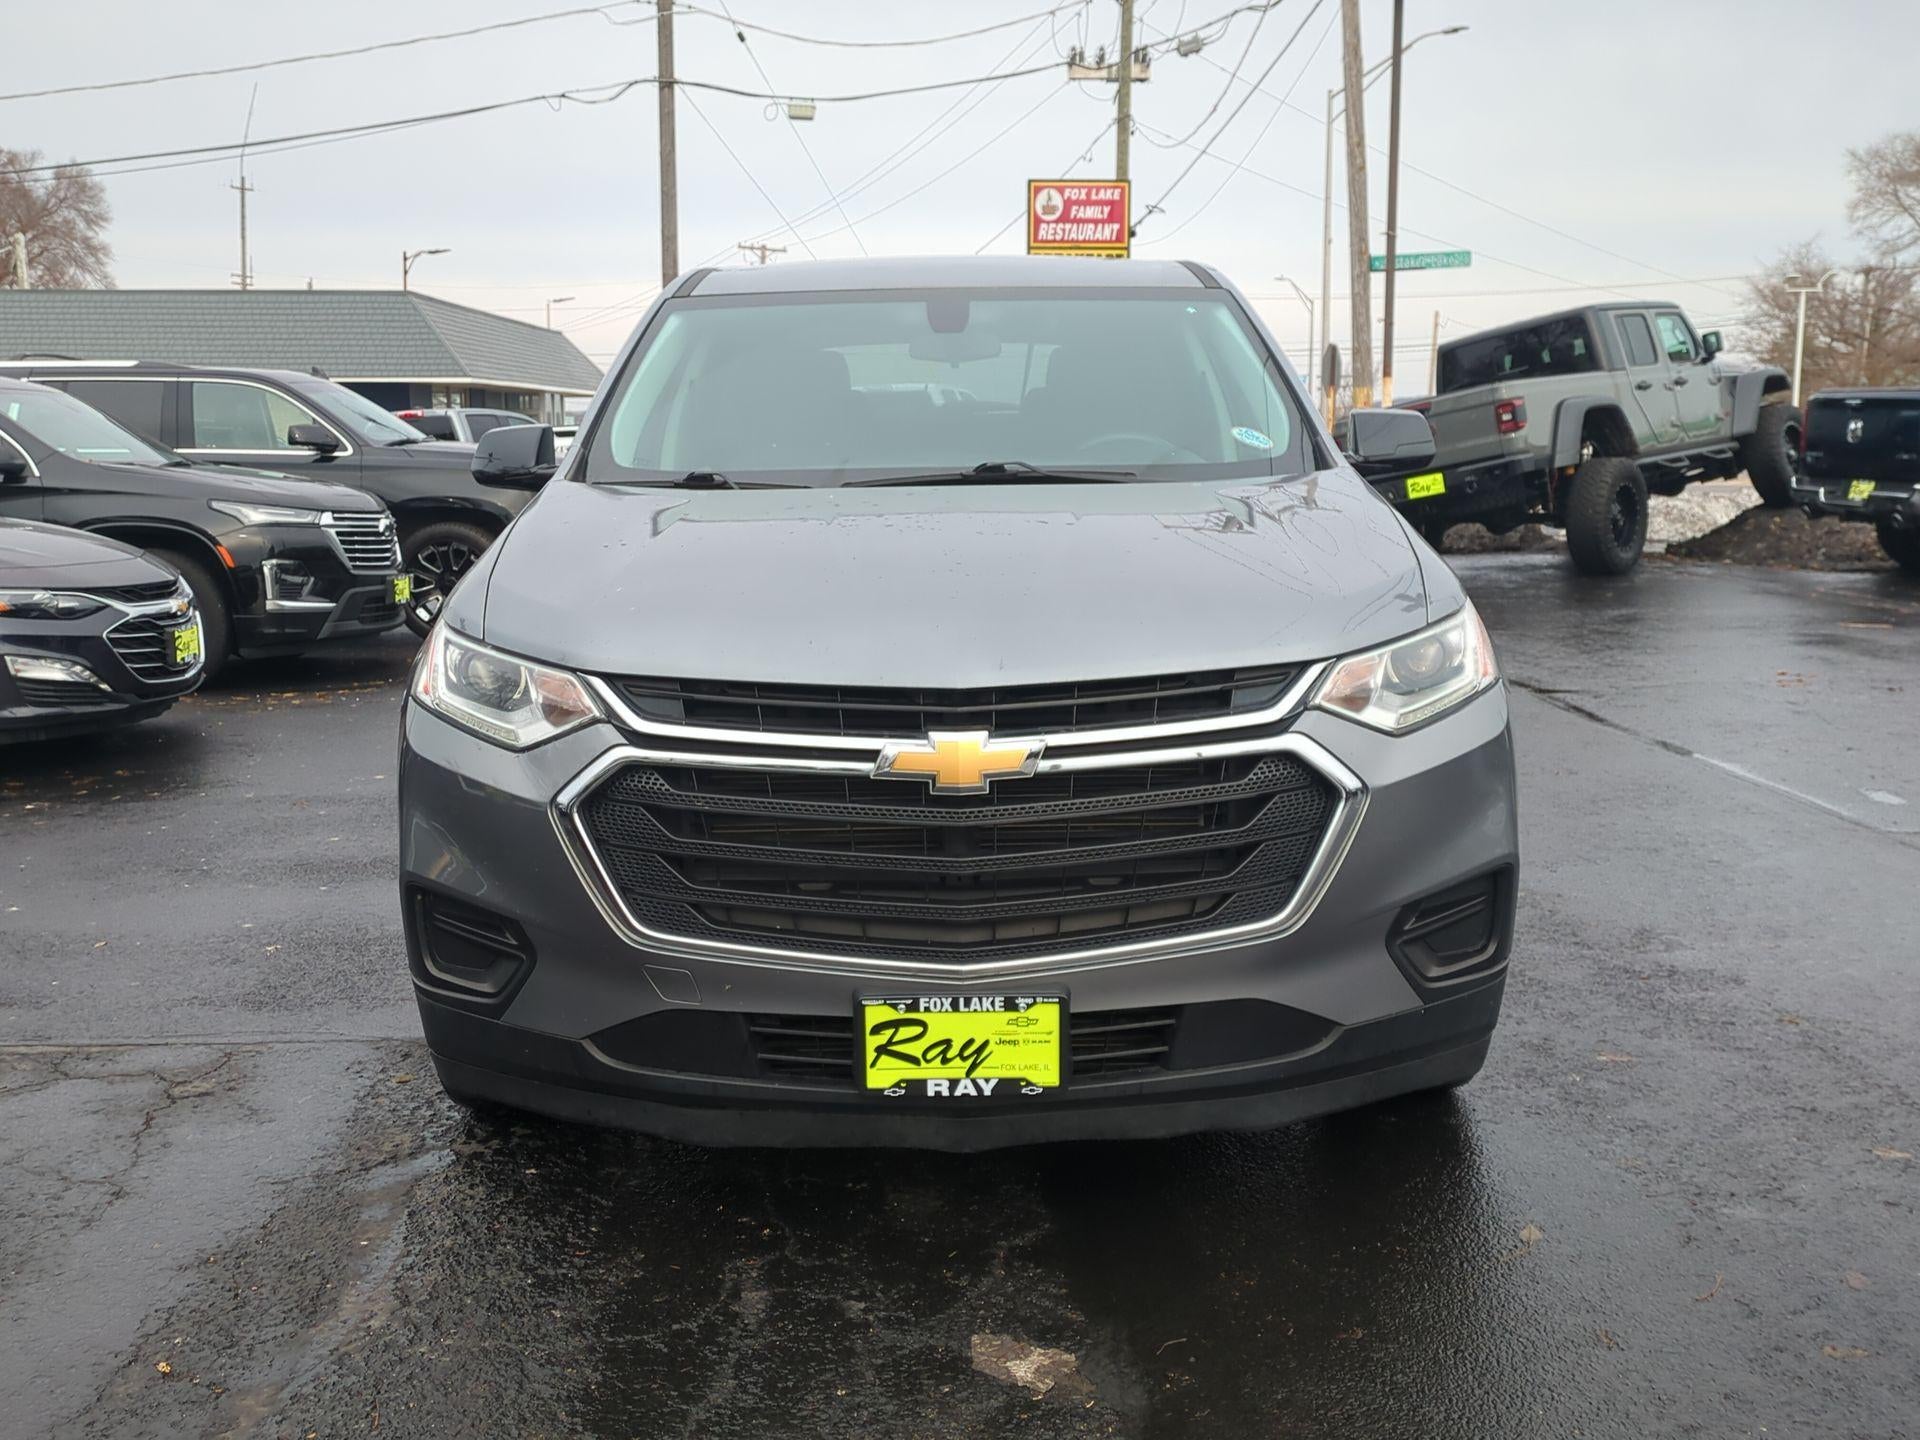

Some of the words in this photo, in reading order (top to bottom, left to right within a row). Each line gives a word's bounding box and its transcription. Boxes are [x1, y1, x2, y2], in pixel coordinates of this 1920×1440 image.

[1063, 188, 1088, 200] FOX
[1091, 188, 1122, 200] LAKE
[1070, 205, 1111, 219] FAMILY
[1038, 223, 1120, 241] RESTAURANT
[919, 997, 953, 1012] FOX
[959, 997, 1005, 1012] LAKE
[869, 1017, 993, 1078] Ray
[995, 1037, 1020, 1047] Jeep
[1000, 1063, 1017, 1071] FOX
[1019, 1063, 1042, 1072] LAKE,
[1043, 1063, 1052, 1071] IL
[927, 1079, 999, 1097] RAY
